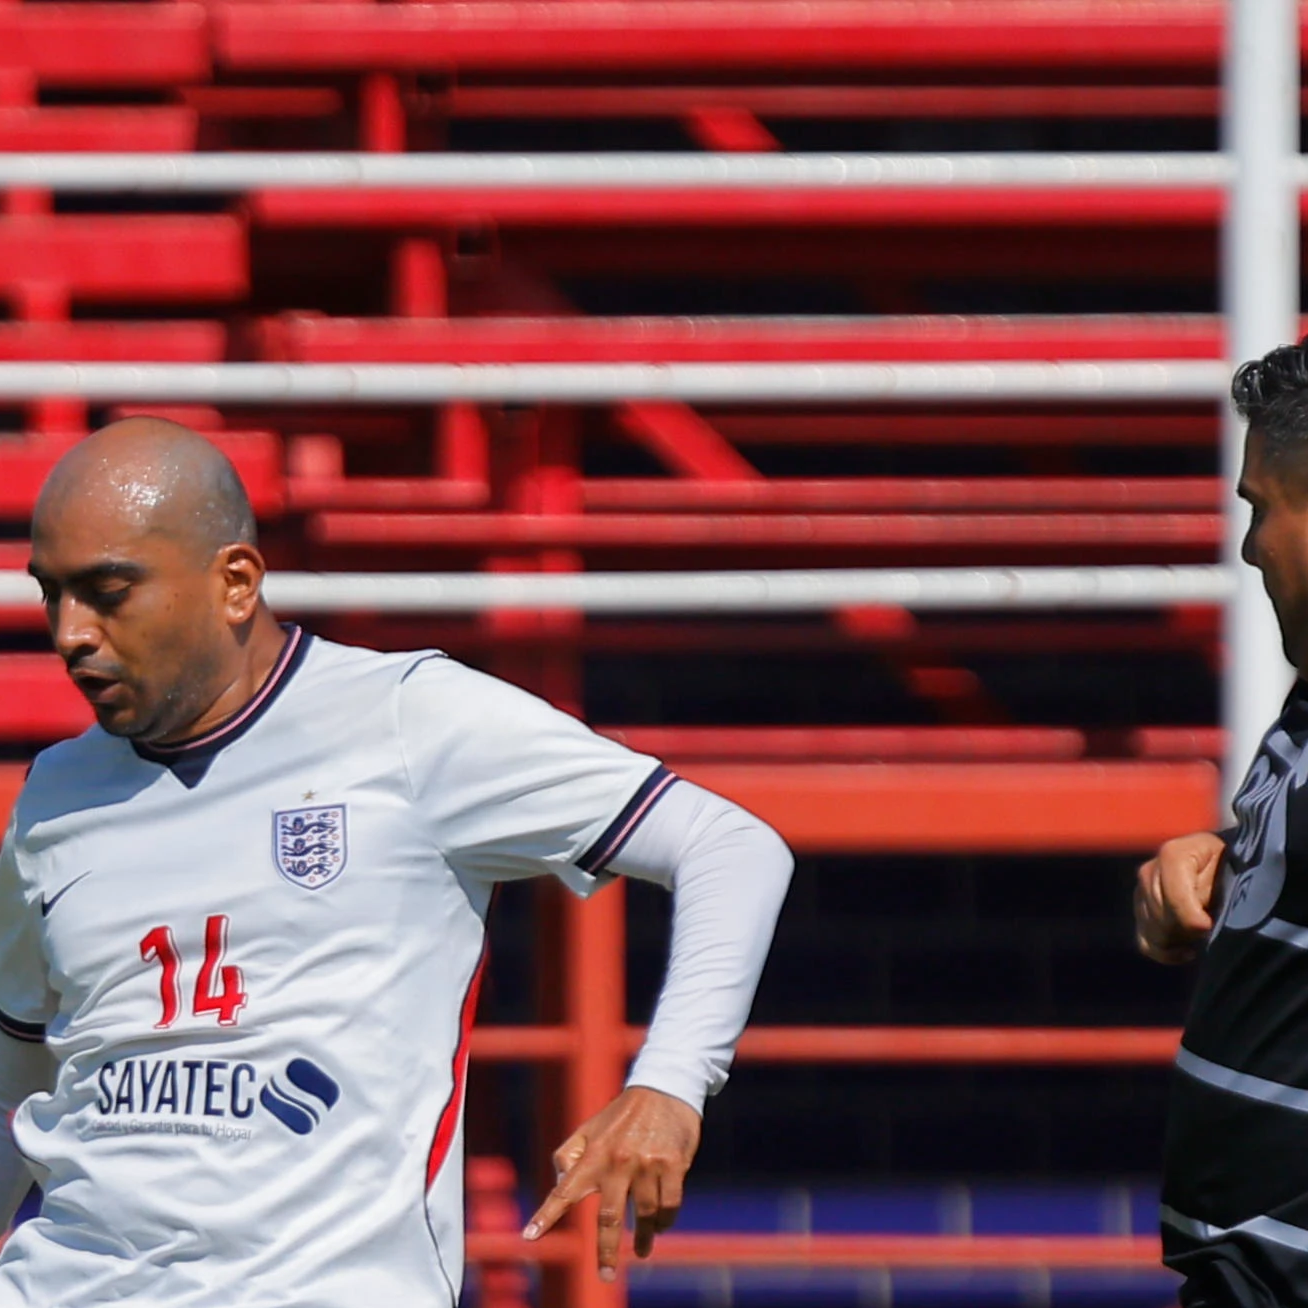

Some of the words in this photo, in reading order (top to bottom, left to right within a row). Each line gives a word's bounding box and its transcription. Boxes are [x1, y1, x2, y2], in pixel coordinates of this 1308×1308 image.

[139, 914, 248, 1029] 14
[98, 1059, 256, 1119] SAYATEC
[174, 1121, 200, 1136] para
[215, 1123, 252, 1142] Hogar
